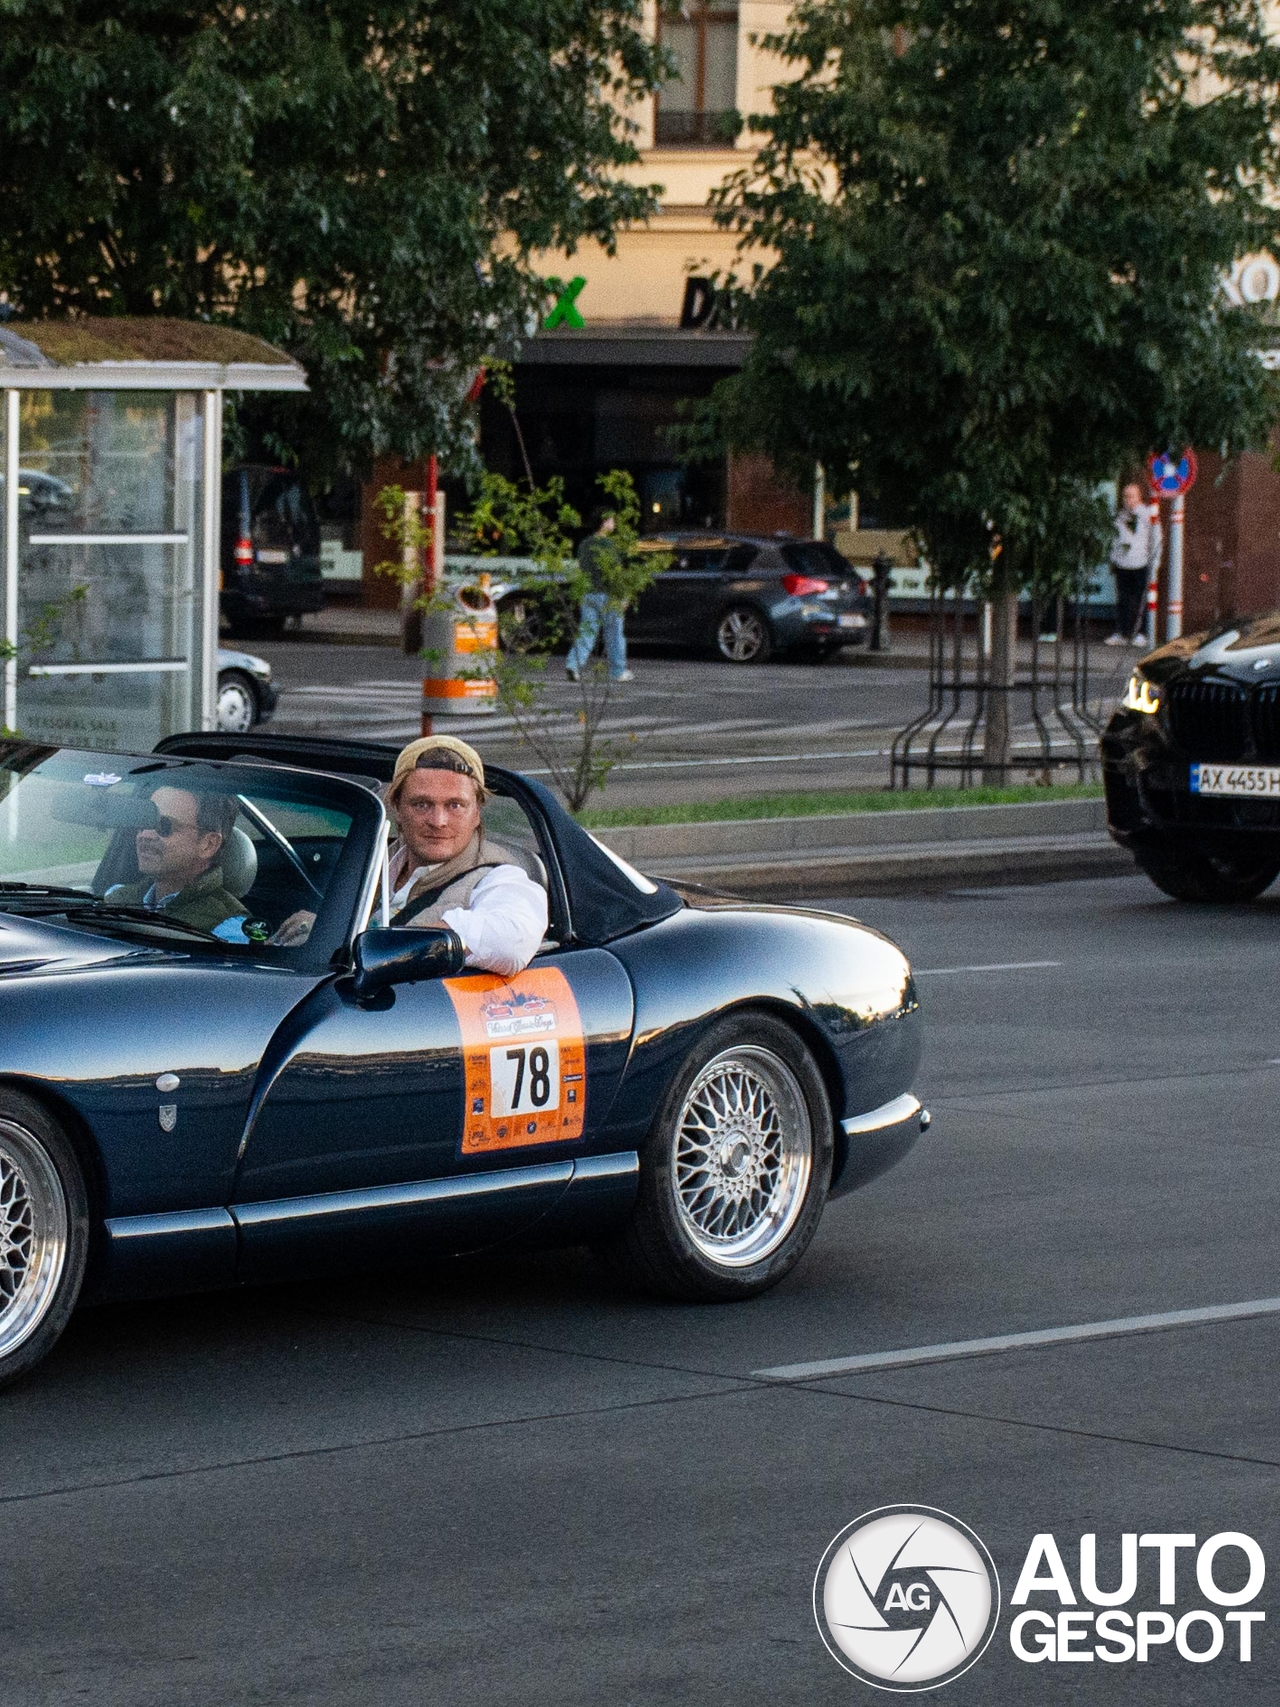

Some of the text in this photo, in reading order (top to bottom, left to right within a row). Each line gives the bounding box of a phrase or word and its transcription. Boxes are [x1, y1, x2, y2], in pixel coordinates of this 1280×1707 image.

[1200, 769, 1223, 790] AX
[1226, 771, 1266, 792] 4455
[506, 1046, 550, 1110] 78
